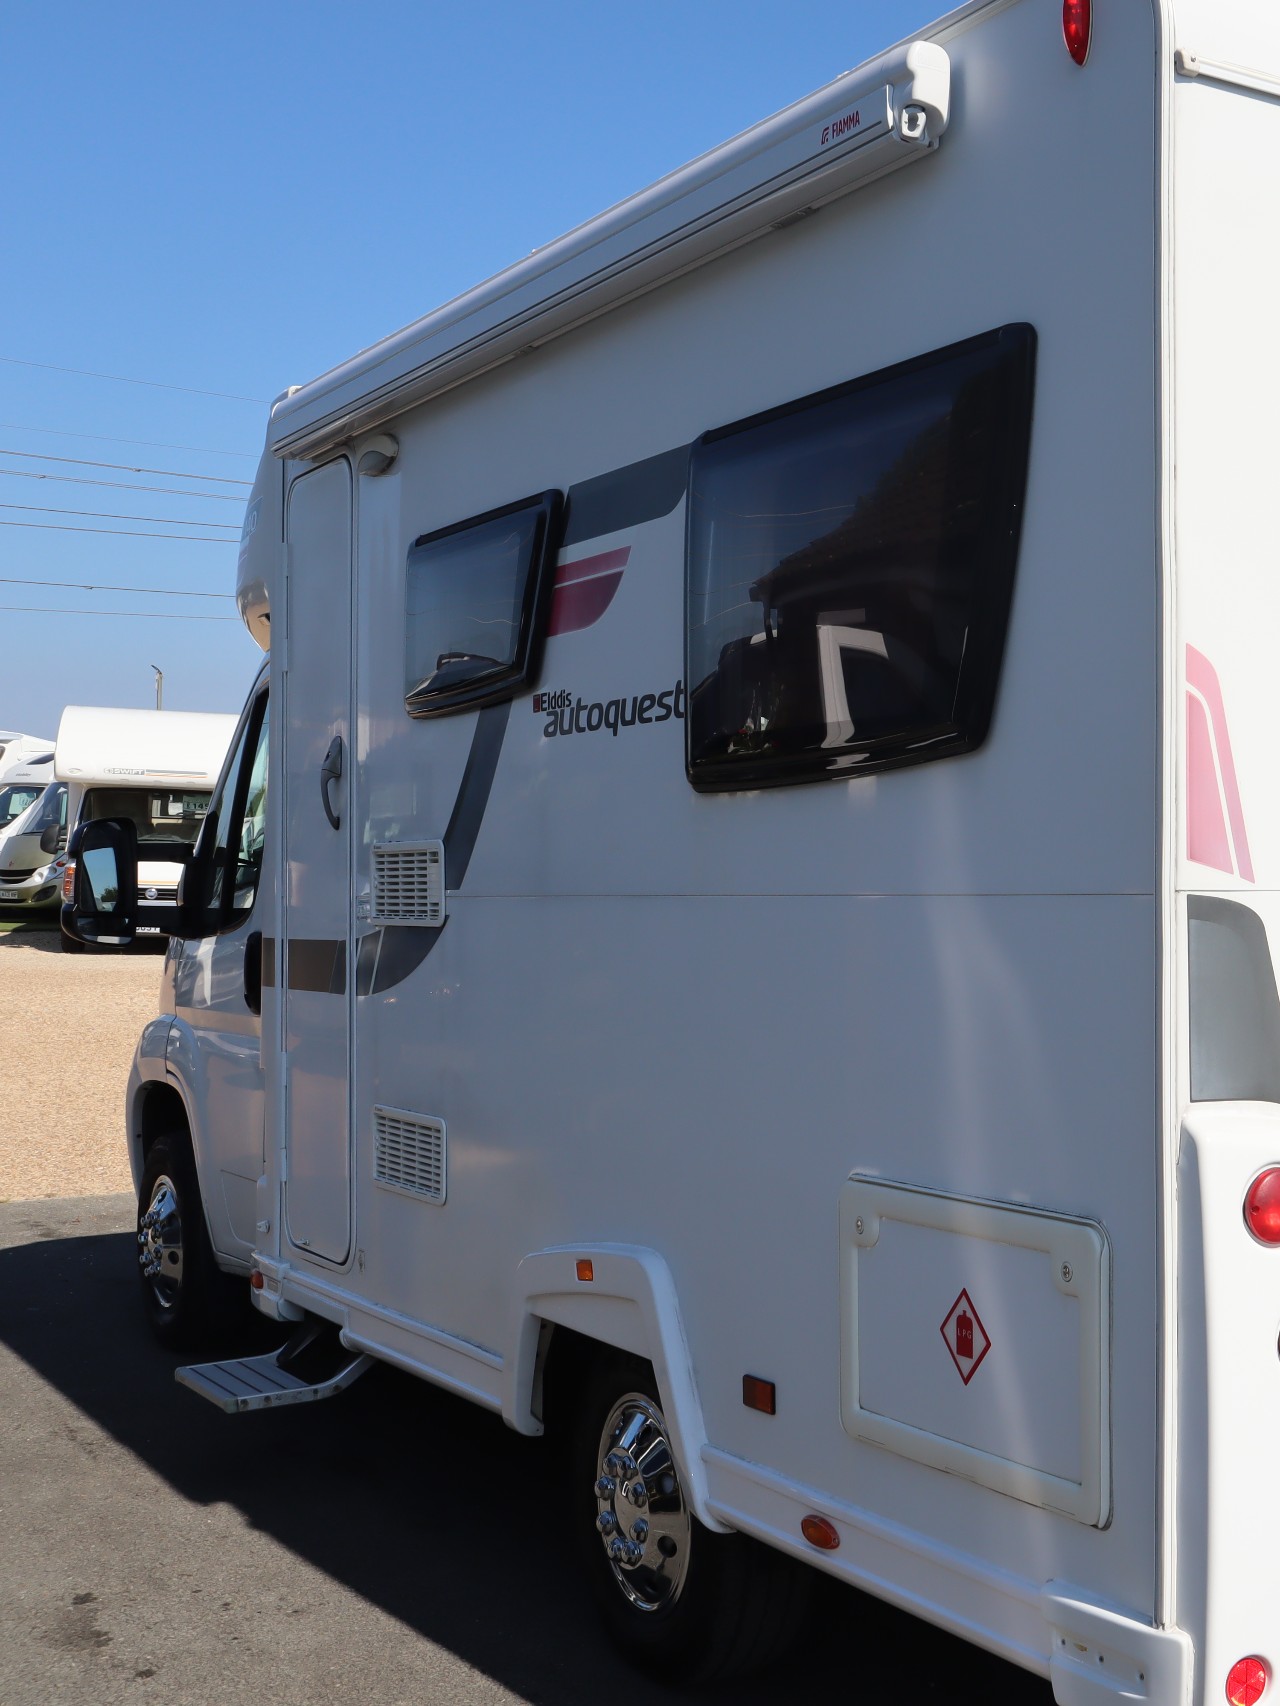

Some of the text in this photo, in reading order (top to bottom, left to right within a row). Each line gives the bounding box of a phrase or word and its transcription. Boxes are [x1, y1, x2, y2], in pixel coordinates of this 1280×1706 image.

[832, 110, 860, 139] FIAMMA
[539, 689, 573, 712] Elddis
[543, 679, 685, 738] autoquest
[957, 1327, 972, 1340] LPG
